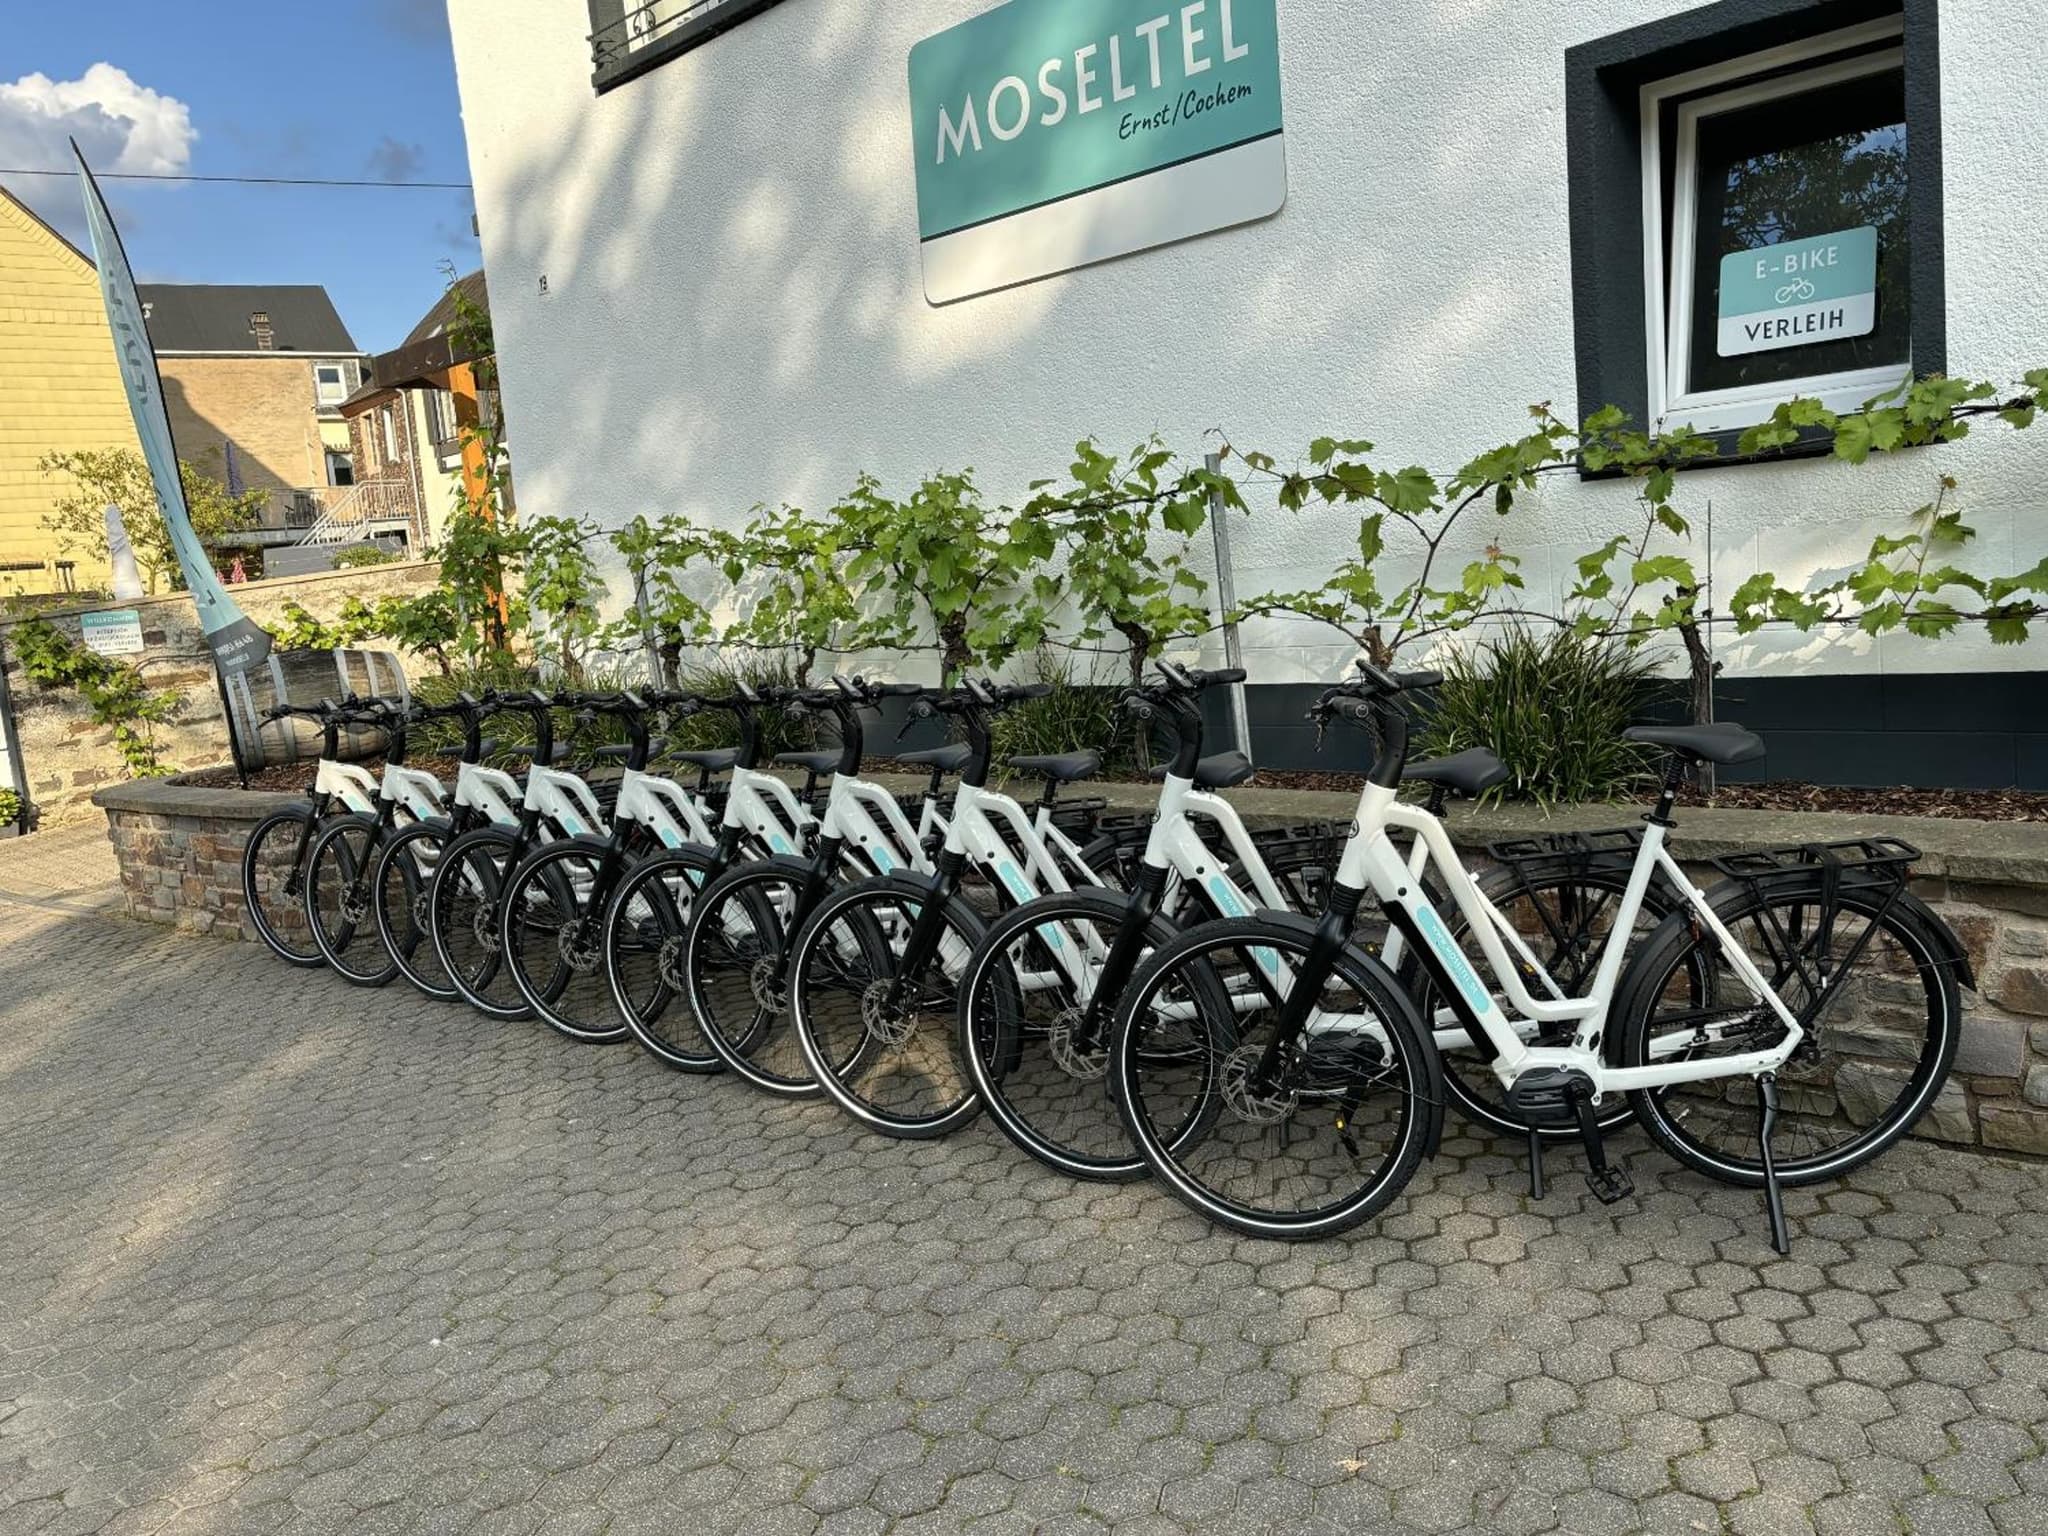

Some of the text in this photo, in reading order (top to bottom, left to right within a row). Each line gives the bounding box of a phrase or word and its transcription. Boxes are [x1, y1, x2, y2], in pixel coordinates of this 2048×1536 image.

[935, 0, 1250, 165] MOSELTEL
[1118, 81, 1253, 140] Ernst/Cochem
[1755, 246, 1839, 279] E-BIKE
[1744, 308, 1844, 341] VERLEIH
